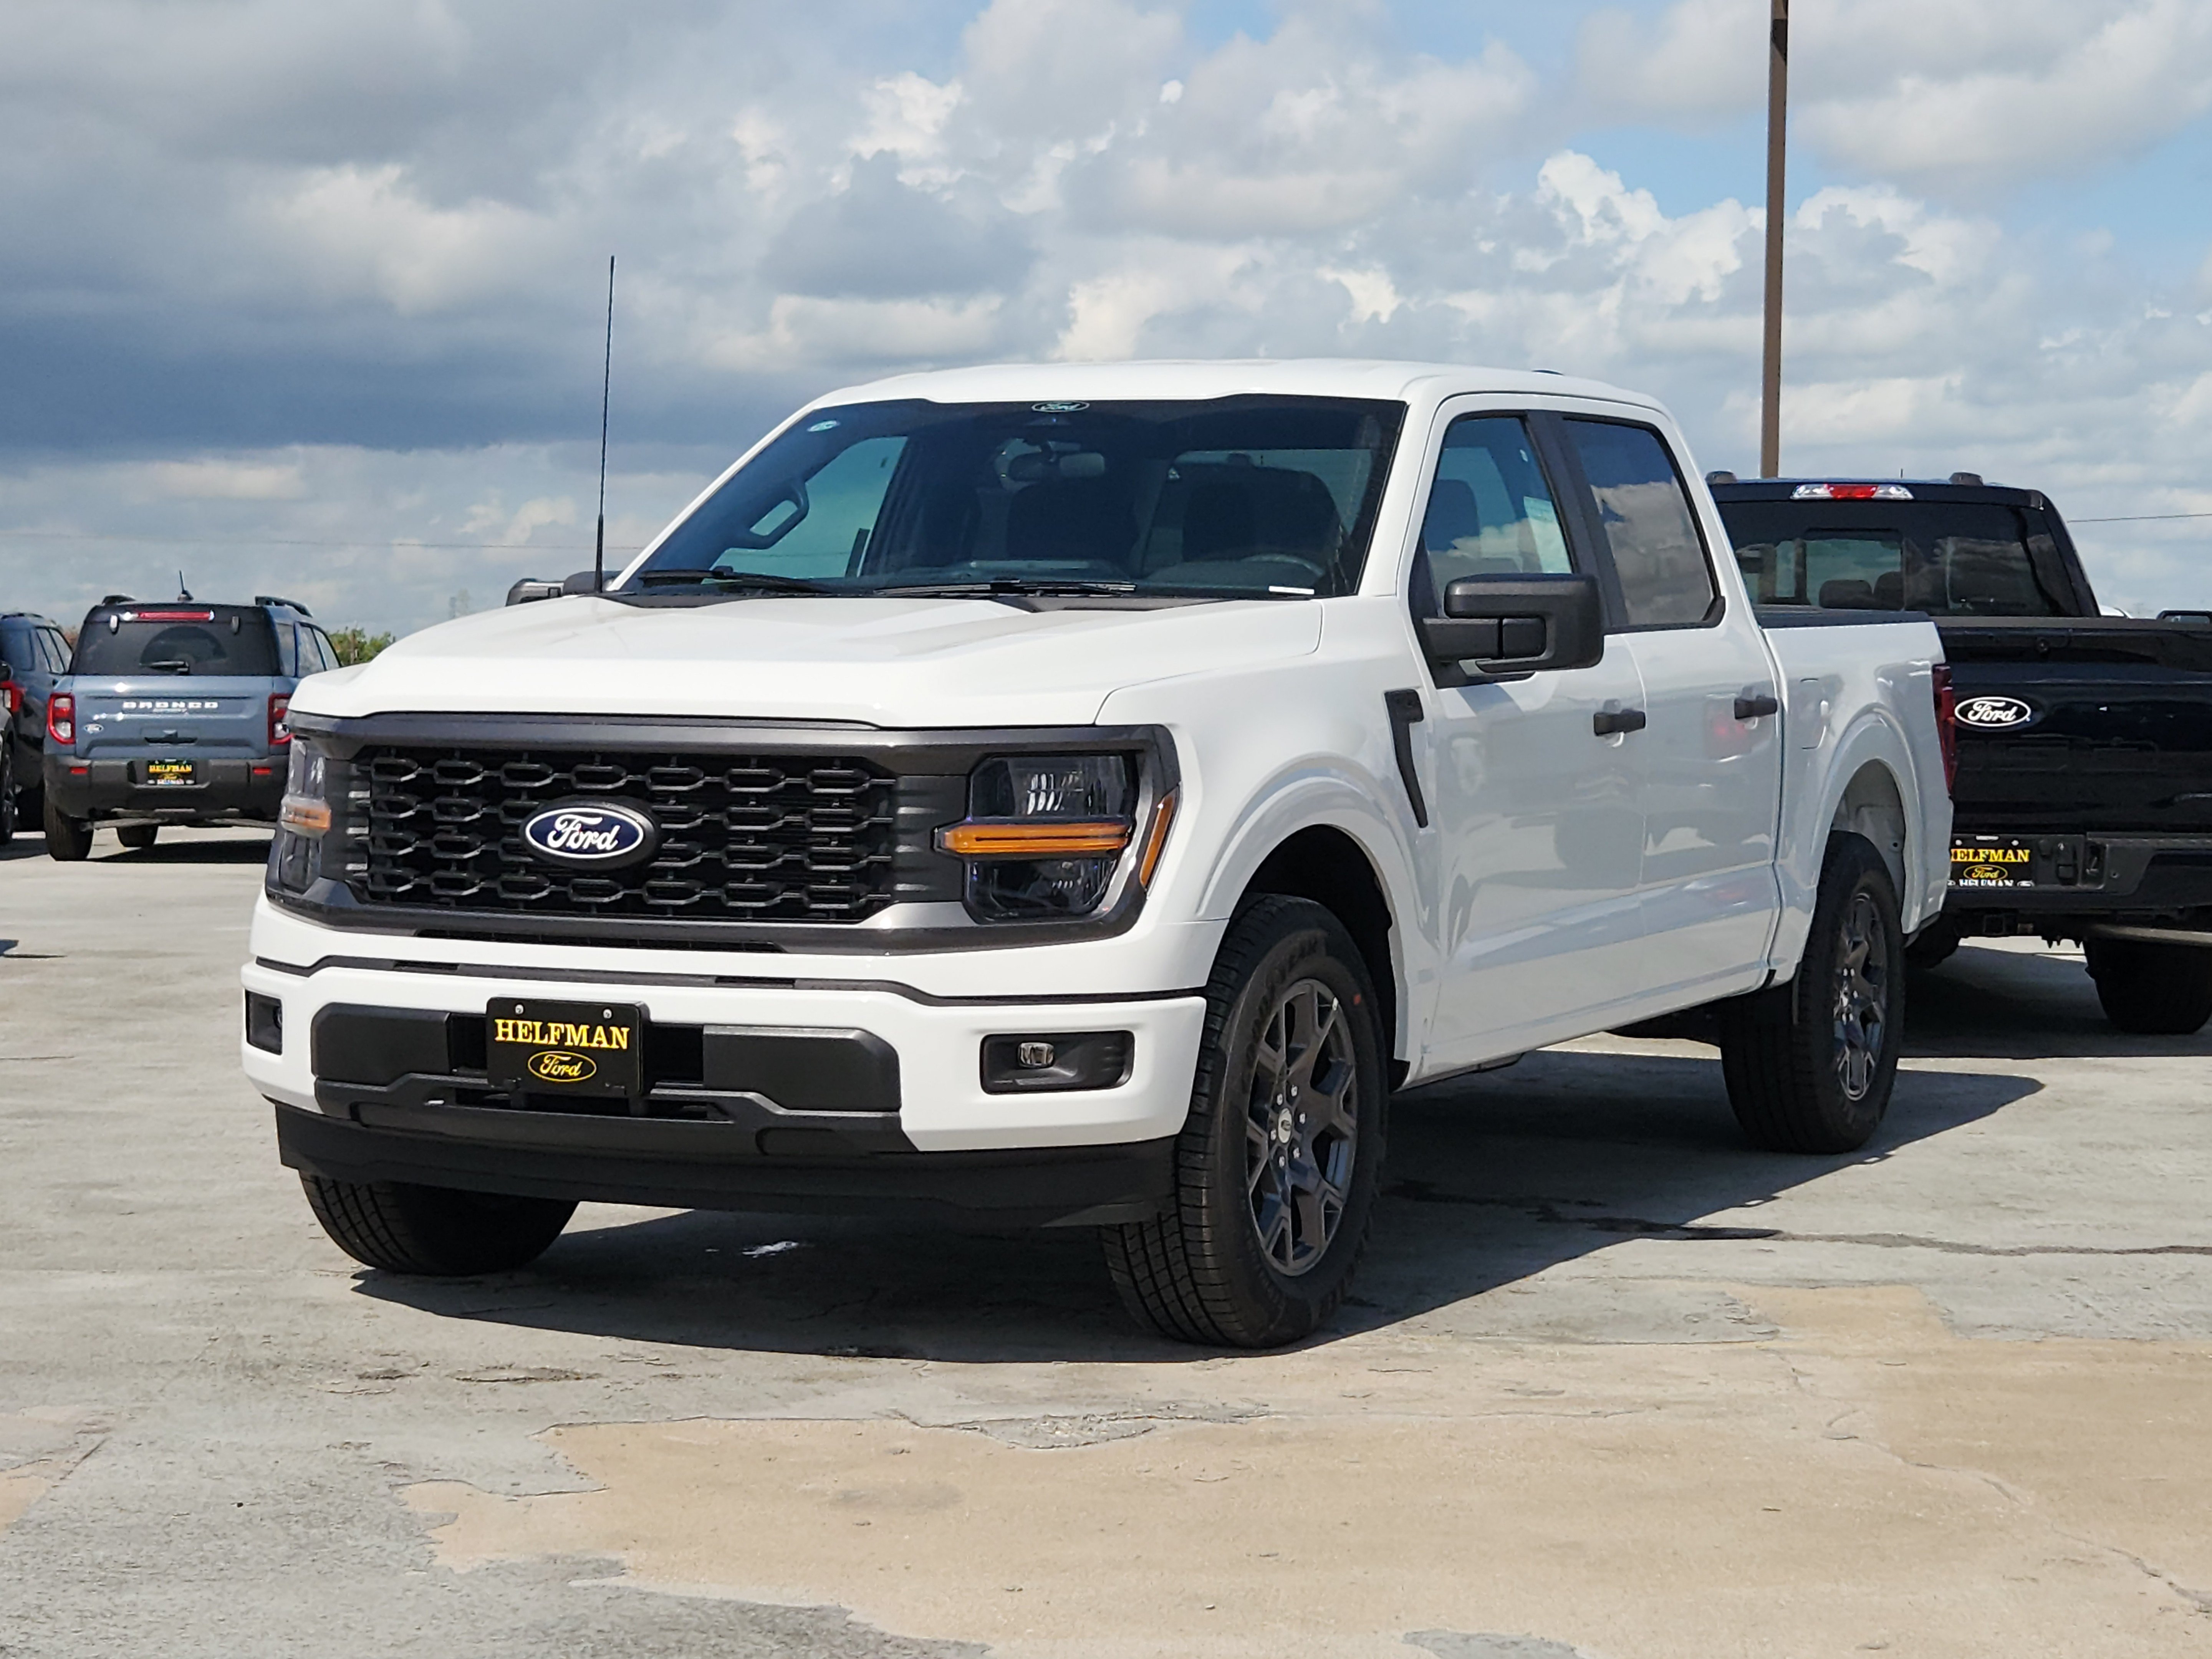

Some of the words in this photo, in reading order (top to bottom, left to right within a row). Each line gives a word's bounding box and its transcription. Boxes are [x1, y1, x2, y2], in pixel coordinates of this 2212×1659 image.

[1968, 701, 2018, 721] Ford
[547, 815, 621, 851] Ford
[1972, 866, 2000, 878] Ford
[495, 1019, 630, 1049] HELFMAN
[540, 1054, 583, 1076] Ford
